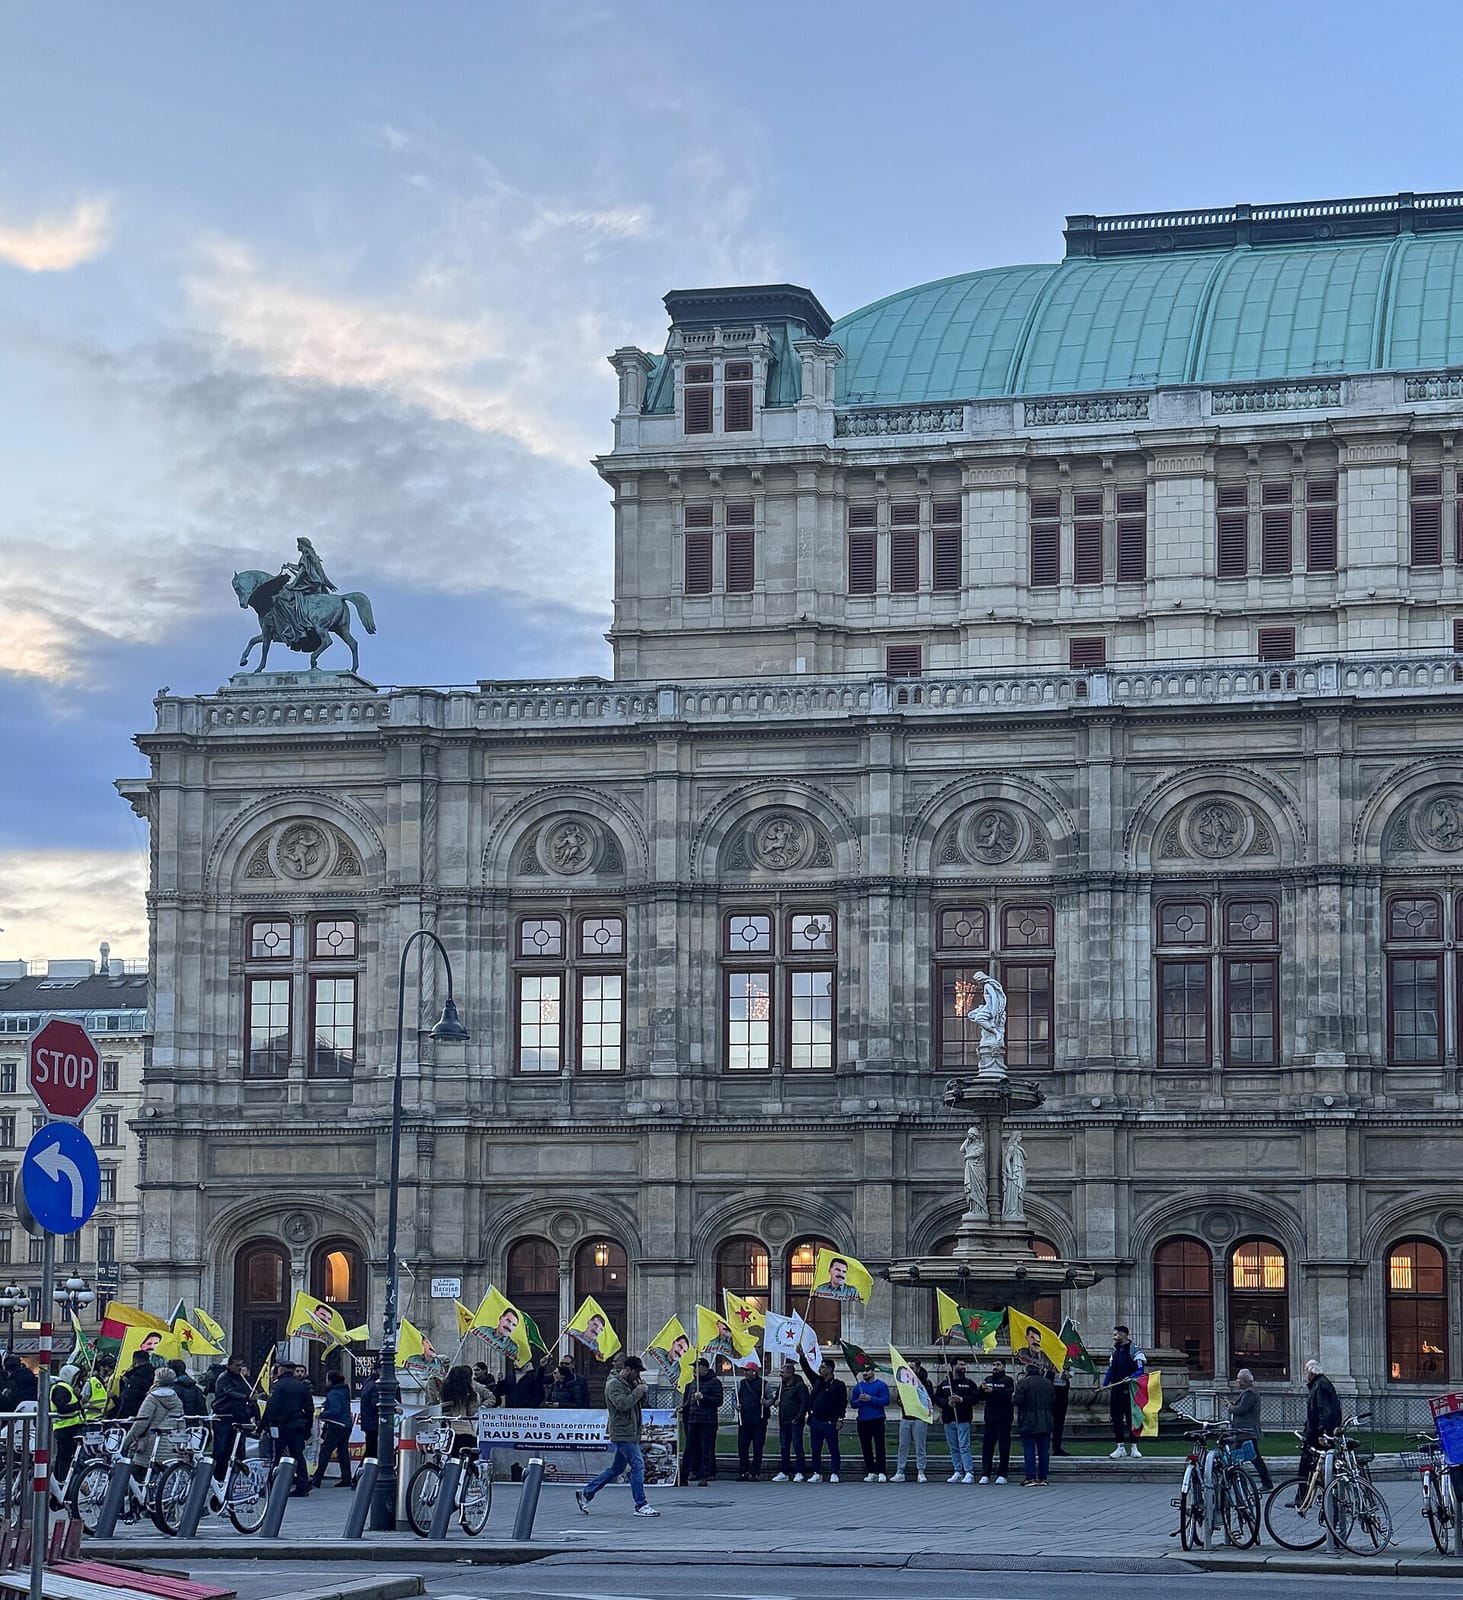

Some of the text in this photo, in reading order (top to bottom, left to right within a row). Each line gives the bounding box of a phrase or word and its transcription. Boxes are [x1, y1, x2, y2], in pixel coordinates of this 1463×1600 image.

[36, 1048, 94, 1090] STOP
[483, 1430, 600, 1441] RAUS AUS AFRIN
